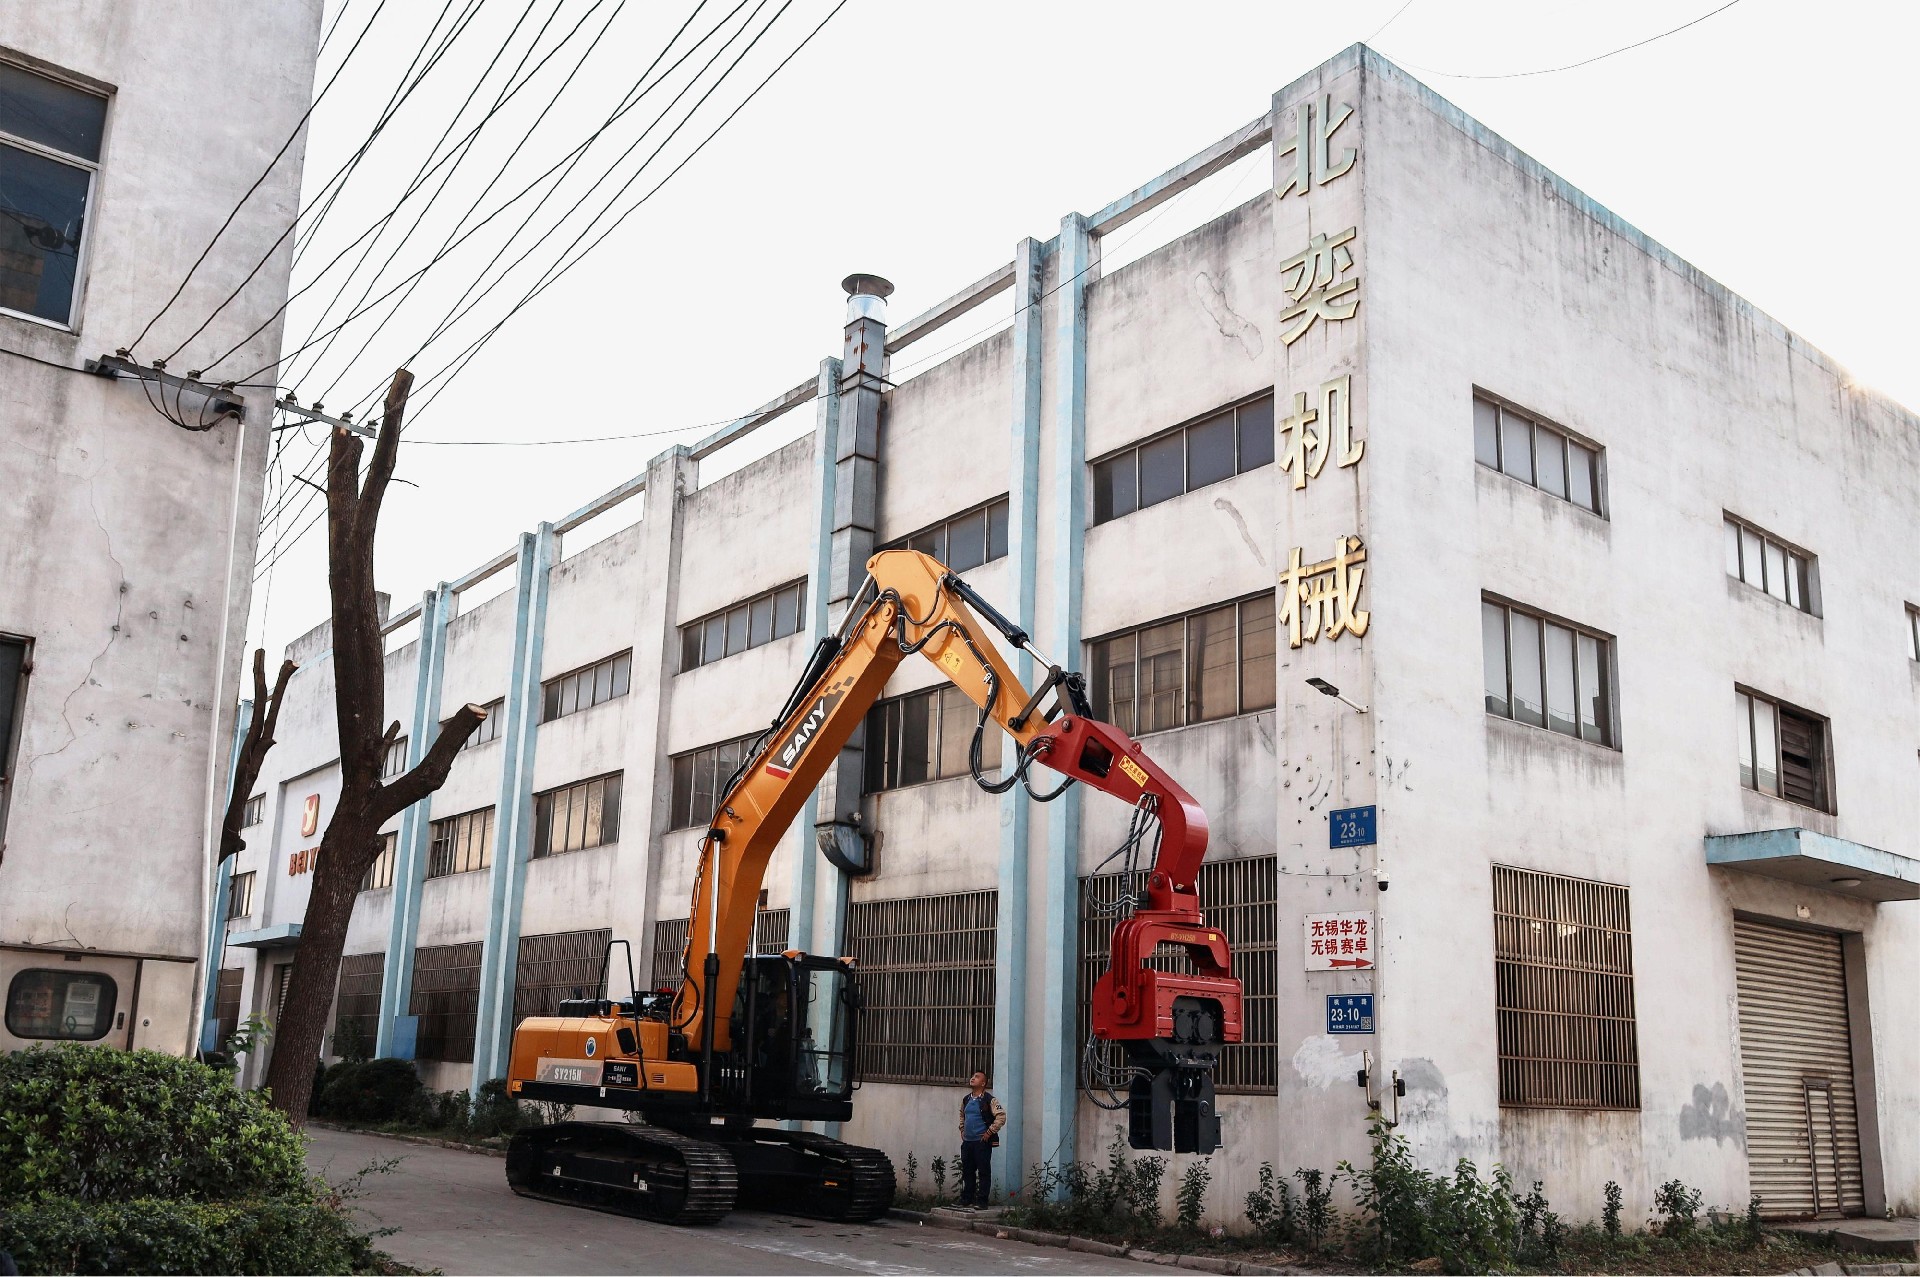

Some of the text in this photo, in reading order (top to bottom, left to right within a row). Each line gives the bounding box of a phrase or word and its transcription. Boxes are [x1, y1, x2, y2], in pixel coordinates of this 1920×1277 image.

[1275, 94, 1371, 649] 北奕机械
[782, 698, 826, 767] SANY
[1311, 919, 1368, 937] 无锡华龙
[1311, 937, 1368, 956] 无锡赛卓
[1331, 1007, 1360, 1022] 23-10
[554, 1067, 582, 1082] SY215H
